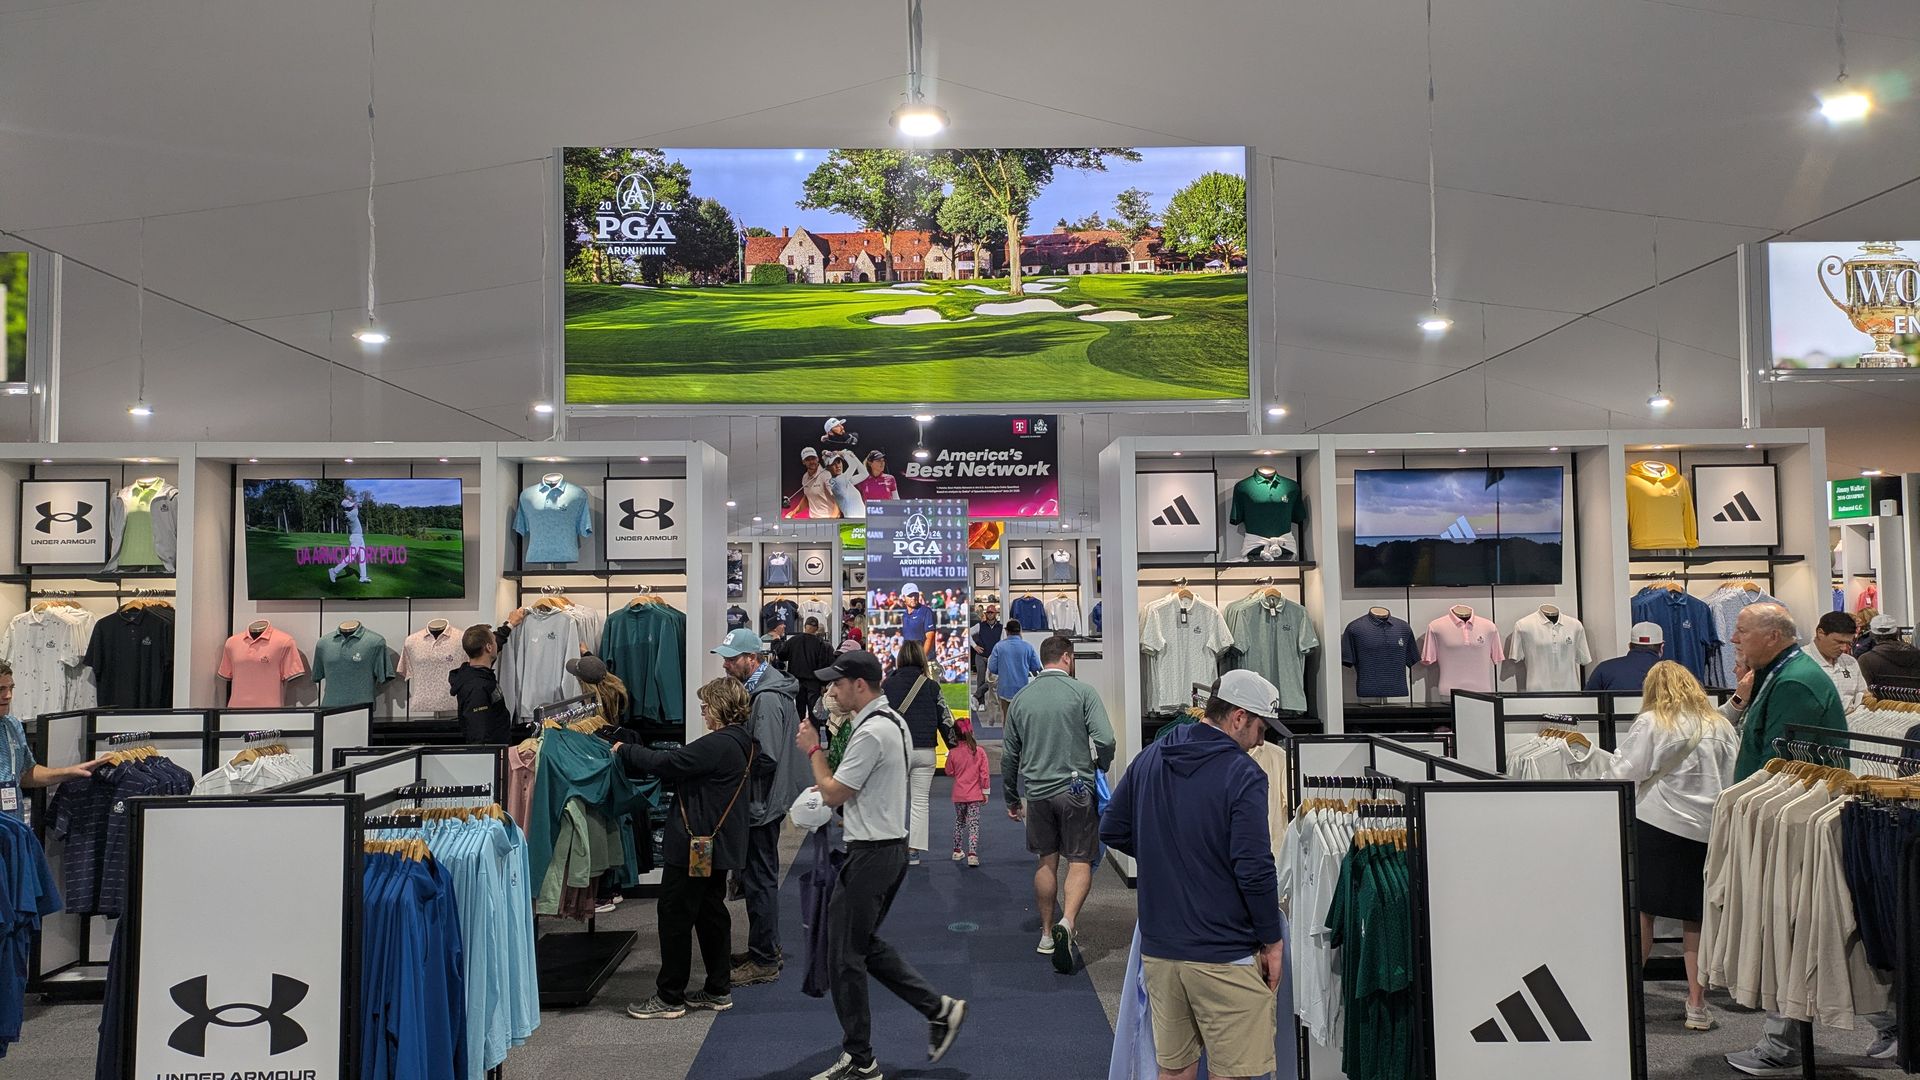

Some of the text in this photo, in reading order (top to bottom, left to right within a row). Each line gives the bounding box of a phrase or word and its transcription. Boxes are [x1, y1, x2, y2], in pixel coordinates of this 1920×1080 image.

[599, 201, 672, 211] 20 26
[596, 216, 676, 239] PGA
[607, 247, 666, 255] ARONIMINK
[936, 448, 1023, 462] America's
[905, 460, 1051, 478] Best Network
[296, 544, 408, 565] UA ARMOUR DRY POLO
[893, 541, 942, 555] PGA
[901, 567, 968, 577] WELCOME TO TH
[157, 1070, 316, 1080] UNDER ARMOUR
